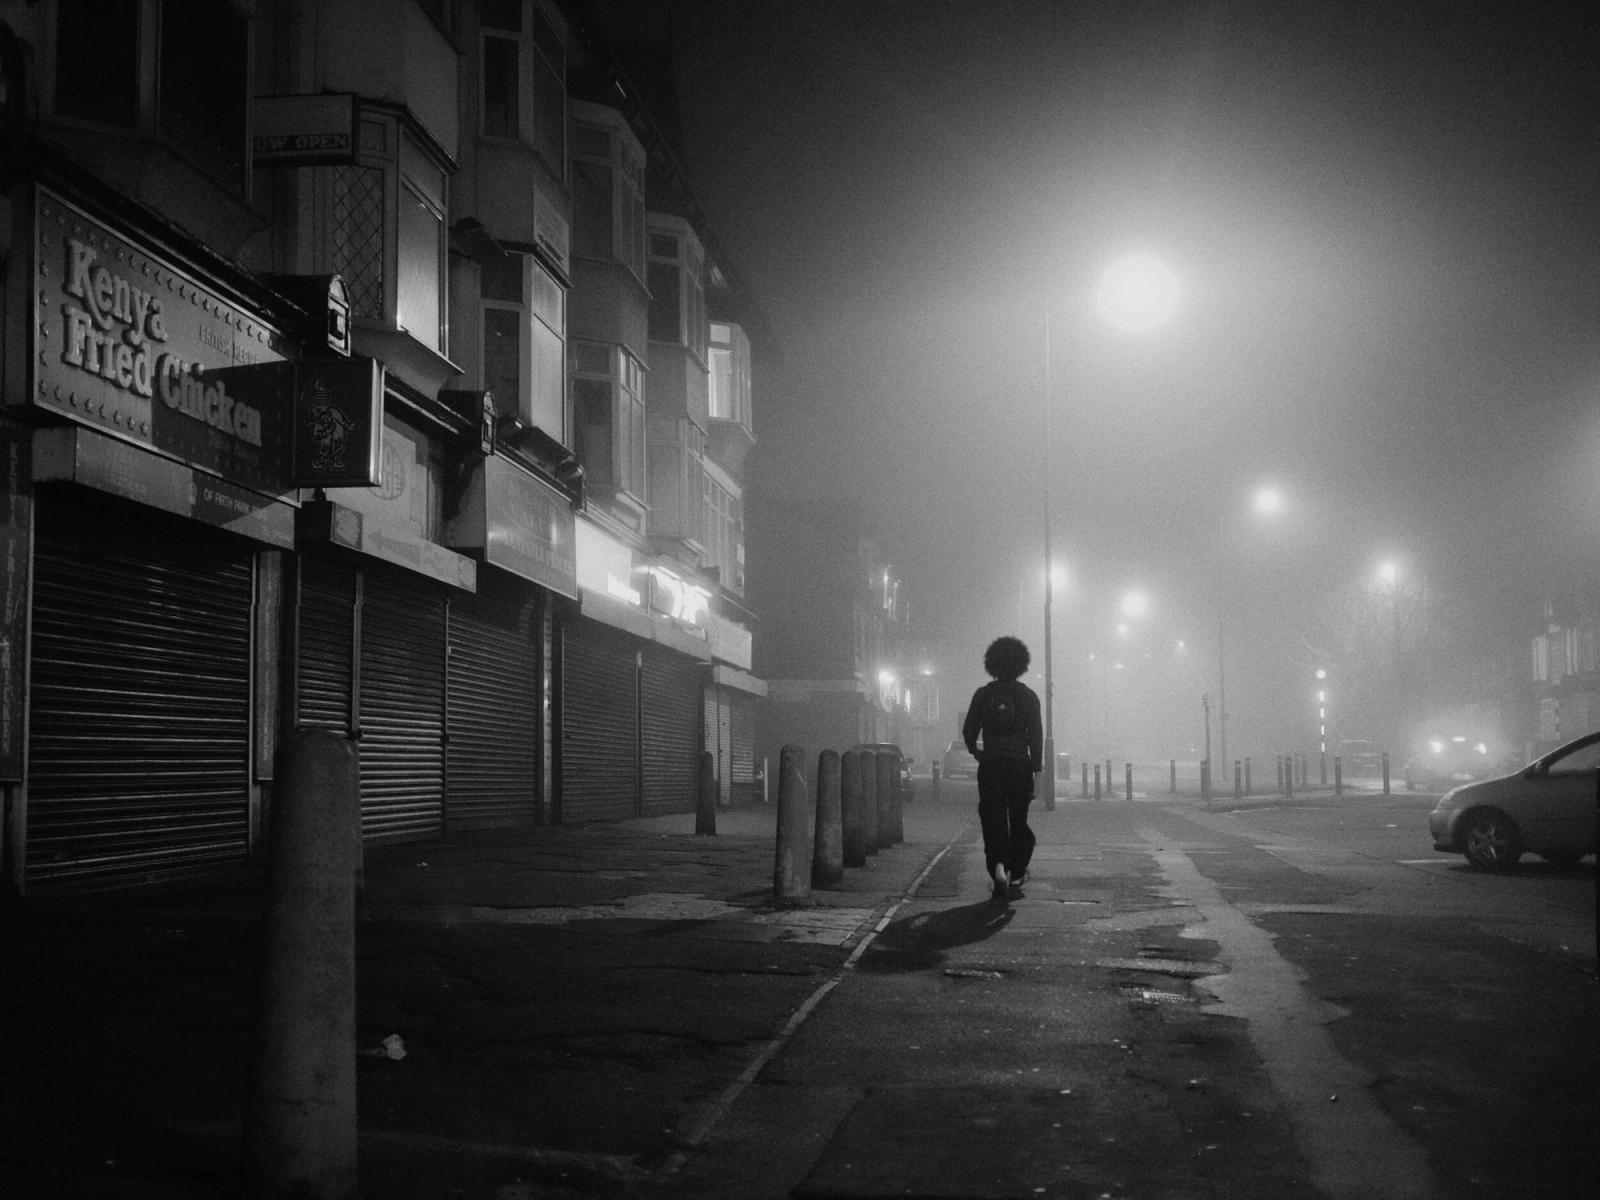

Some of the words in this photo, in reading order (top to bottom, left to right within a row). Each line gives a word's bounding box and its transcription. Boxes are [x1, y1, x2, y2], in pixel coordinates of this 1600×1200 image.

[255, 136, 287, 151] OW
[295, 134, 347, 149] OPEN
[64, 237, 167, 347] Kenya
[62, 303, 154, 398] Fried
[157, 352, 263, 448] Chicken
